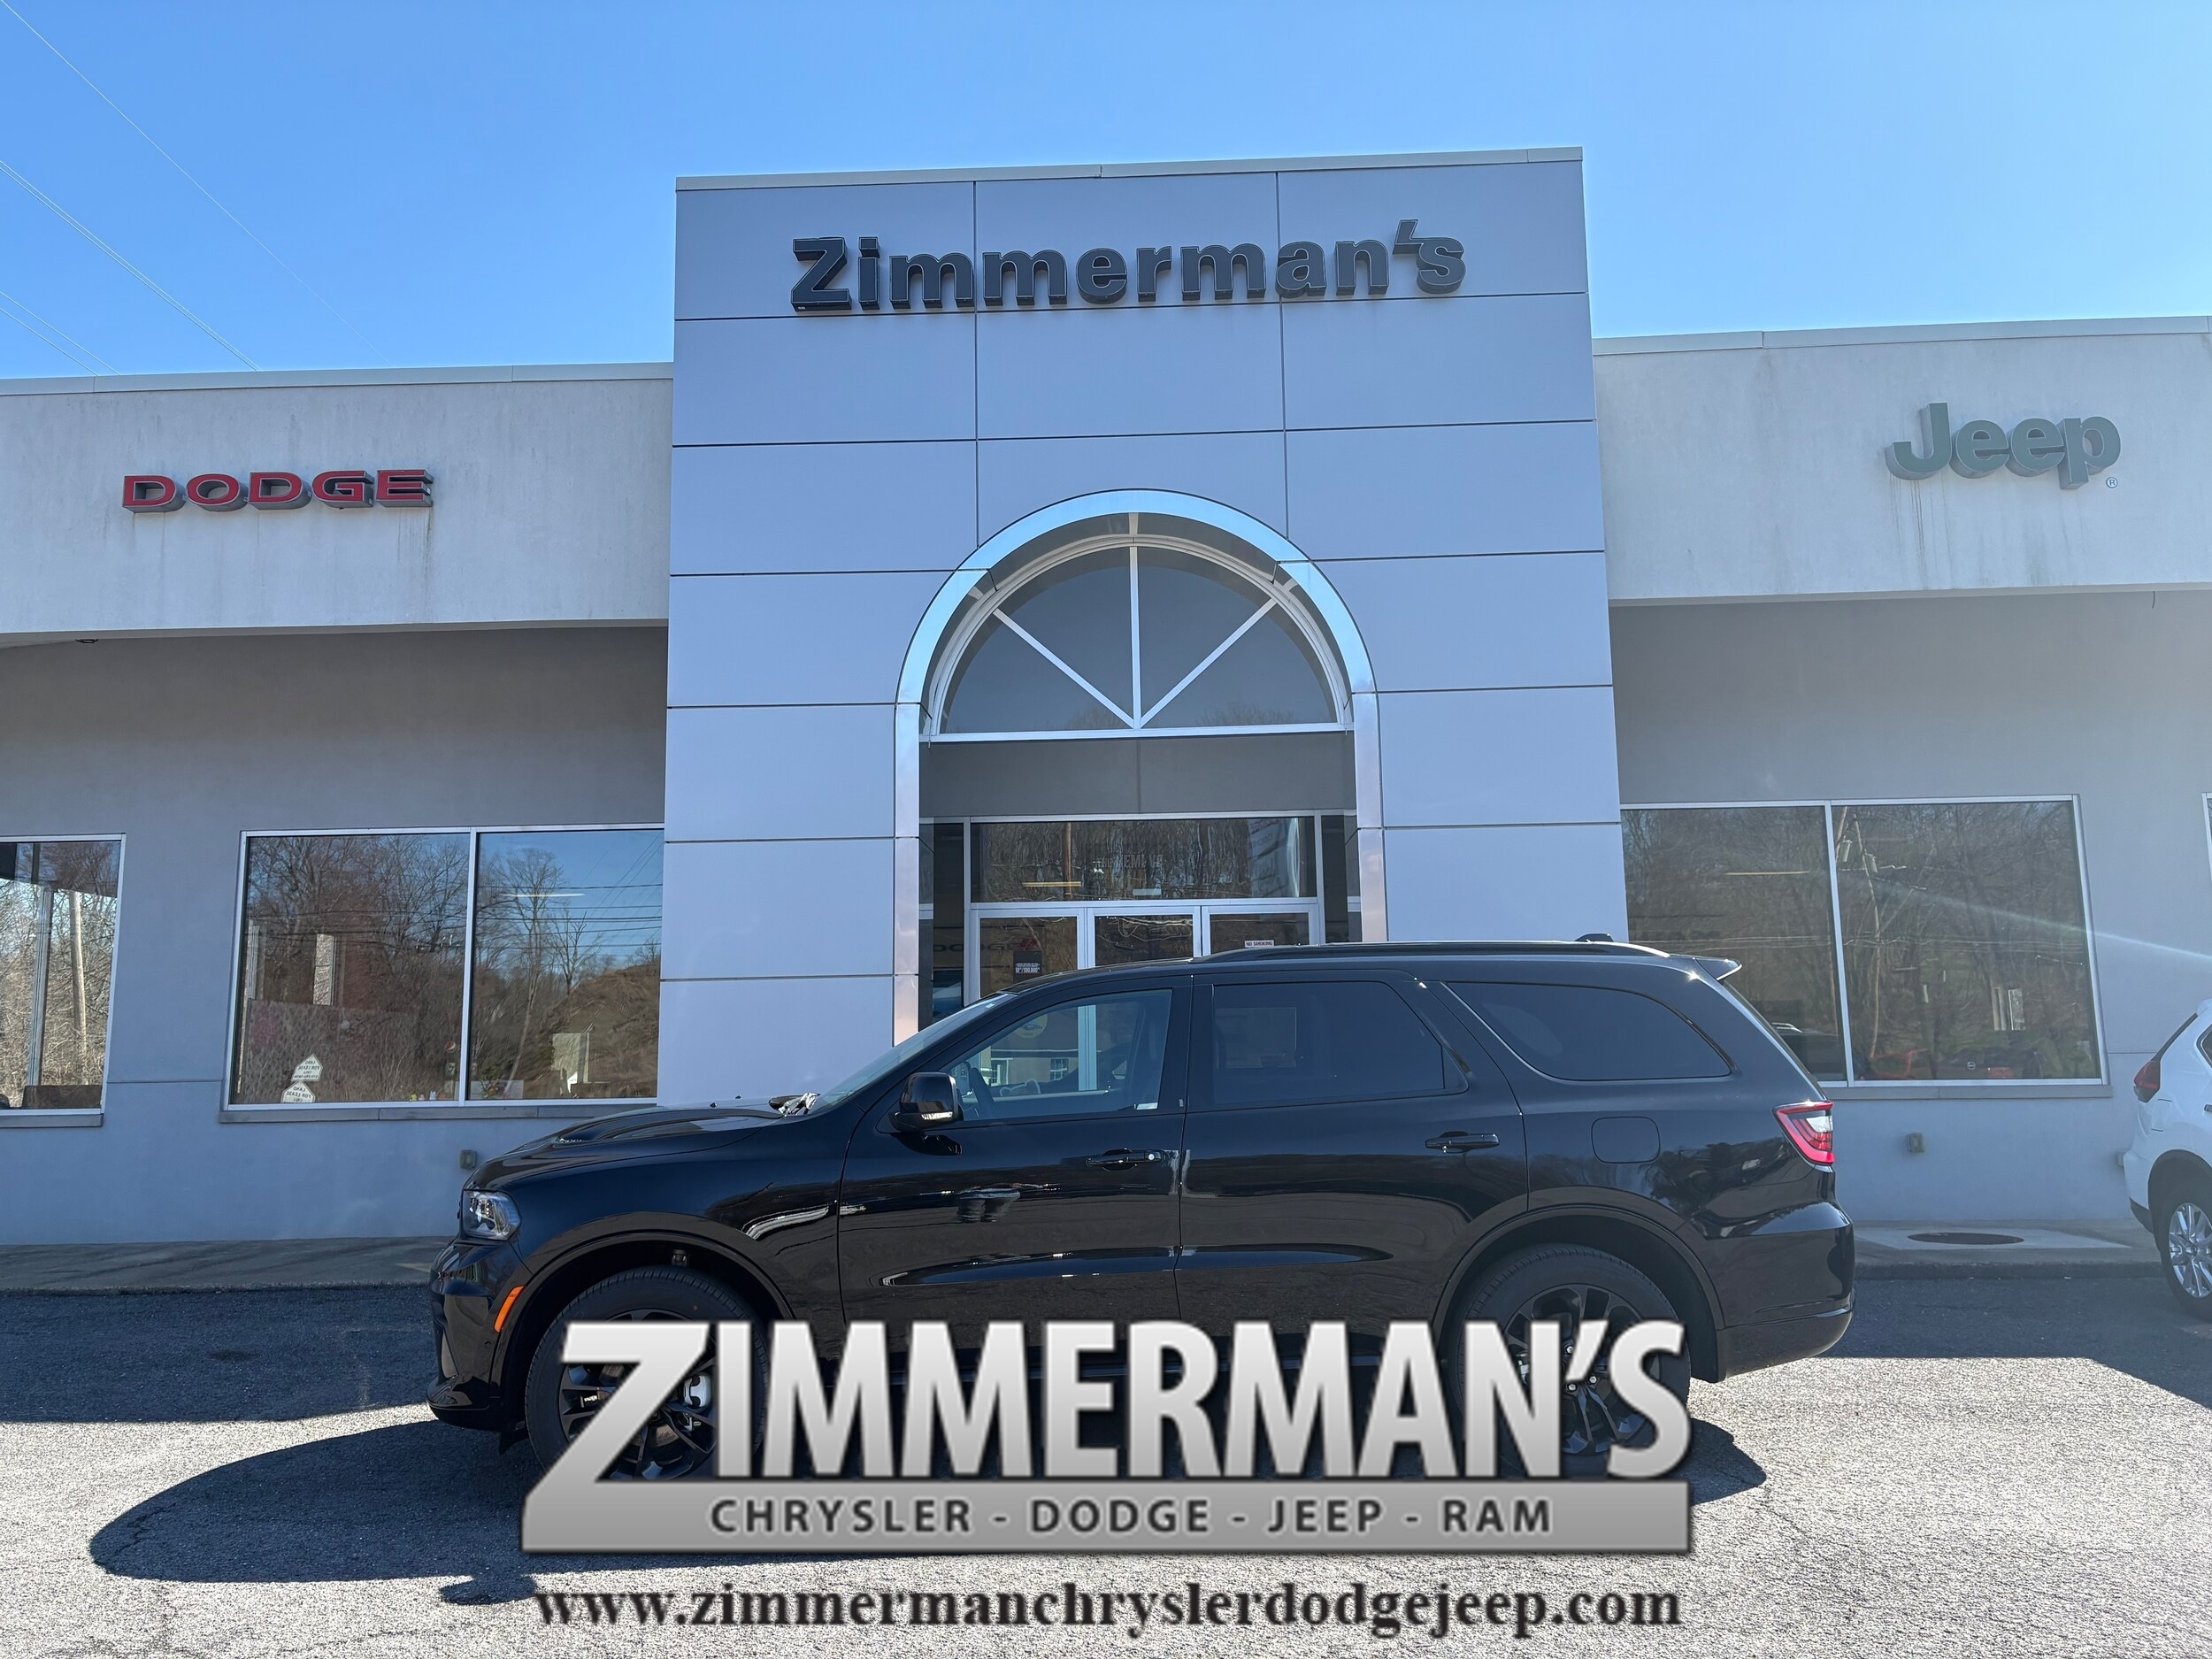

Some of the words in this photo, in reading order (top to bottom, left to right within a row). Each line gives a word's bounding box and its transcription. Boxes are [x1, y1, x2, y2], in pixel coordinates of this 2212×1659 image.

[790, 219, 1467, 311] Zimmerman's
[1885, 402, 2121, 489] Jeep
[122, 470, 434, 512] DODGE
